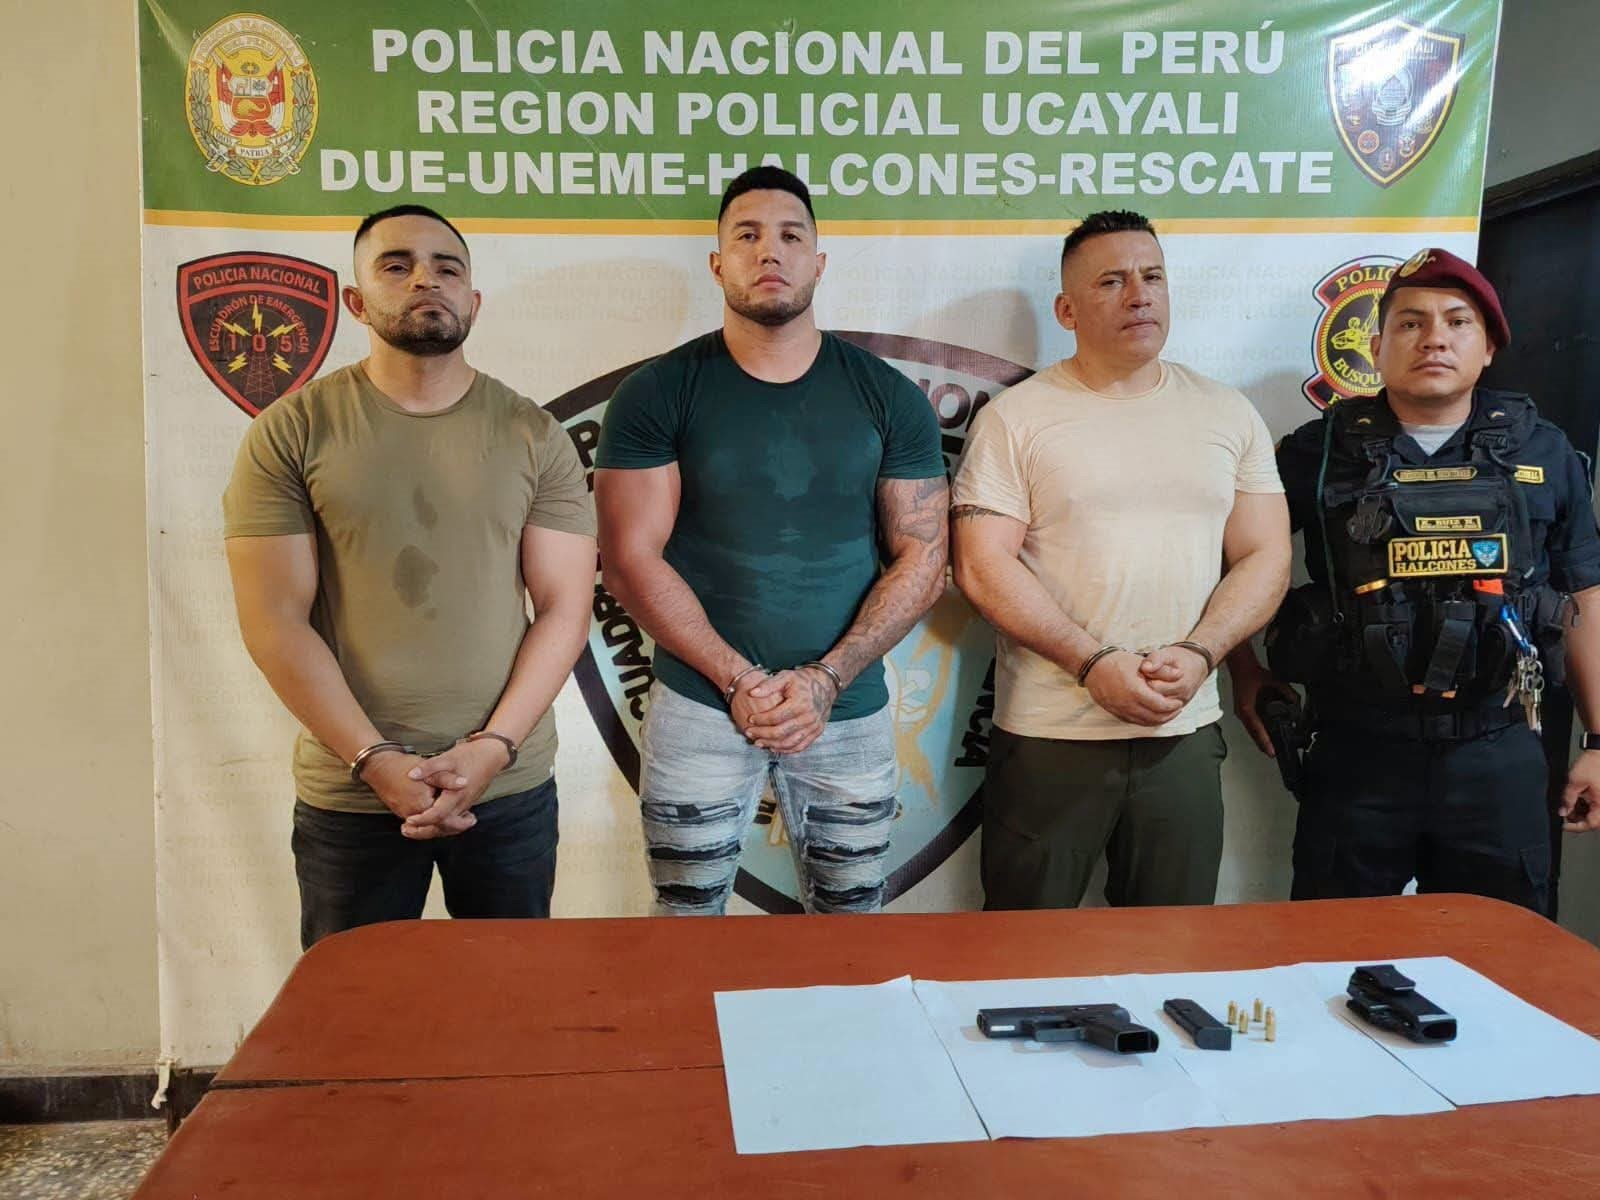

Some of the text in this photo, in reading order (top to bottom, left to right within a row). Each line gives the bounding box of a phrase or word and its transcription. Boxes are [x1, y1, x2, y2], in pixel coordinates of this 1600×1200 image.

[372, 20, 1286, 76] POLICIA NACIONAL DEL PERÚ
[417, 90, 1239, 136] REGION POLICIAL UCAYALI
[320, 149, 1334, 196] DUE-UNEME-HLCONES-RESCATE
[193, 266, 321, 294] POLICIA NACIONAL
[1394, 538, 1473, 562] POLICIA
[1395, 557, 1478, 574] HALCONES
